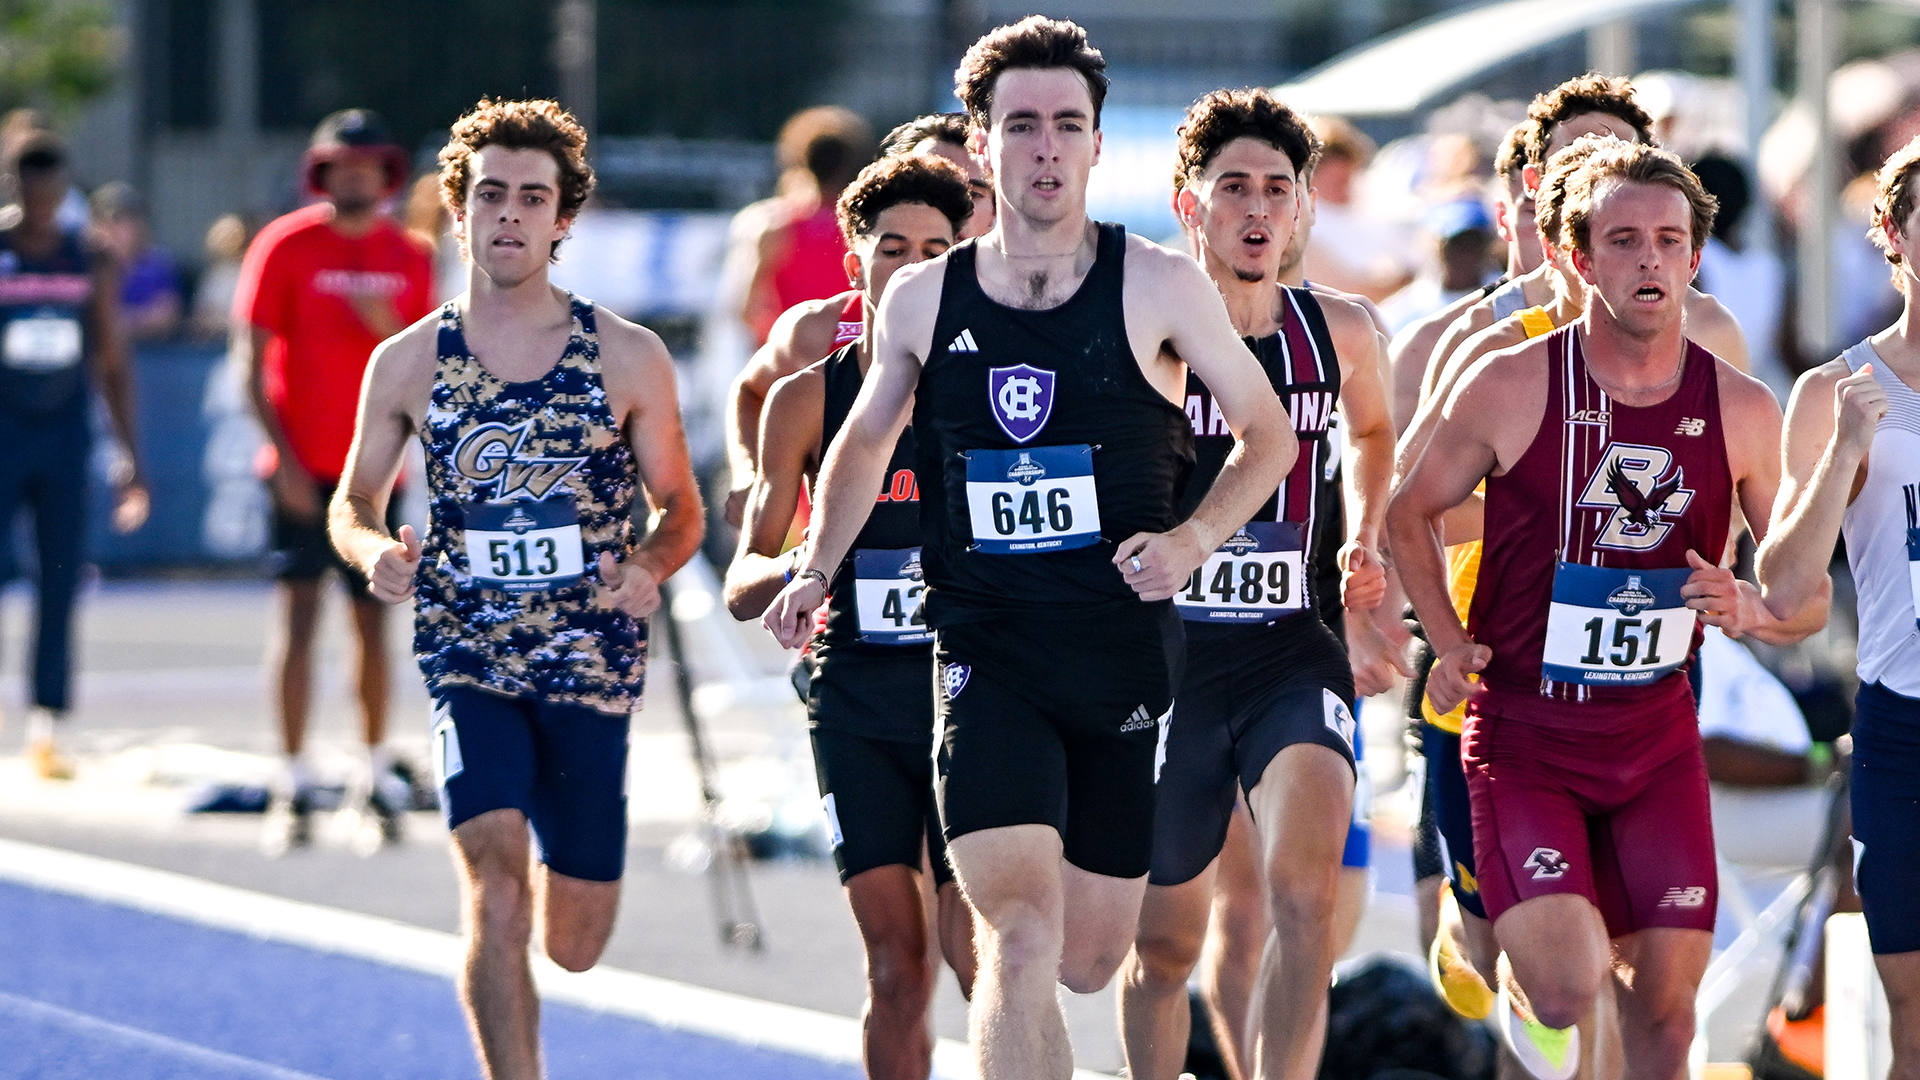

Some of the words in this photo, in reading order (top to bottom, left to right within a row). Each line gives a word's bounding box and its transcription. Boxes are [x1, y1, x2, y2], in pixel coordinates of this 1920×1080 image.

[1568, 409, 1611, 423] ACC
[452, 418, 590, 502] GW
[1008, 468, 1045, 477] CHAMPIONSHIPS
[991, 487, 1073, 536] 646
[1036, 540, 1063, 549] KENTUCKY
[488, 536, 559, 577] 513
[1185, 560, 1290, 605] 1489
[1608, 596, 1654, 605] CHAMPIONSHIPS
[1580, 616, 1663, 667] 151
[1584, 671, 1622, 680] LEXINGTON,
[1623, 671, 1655, 680] KENTUCKY
[1120, 719, 1155, 733] adidas
